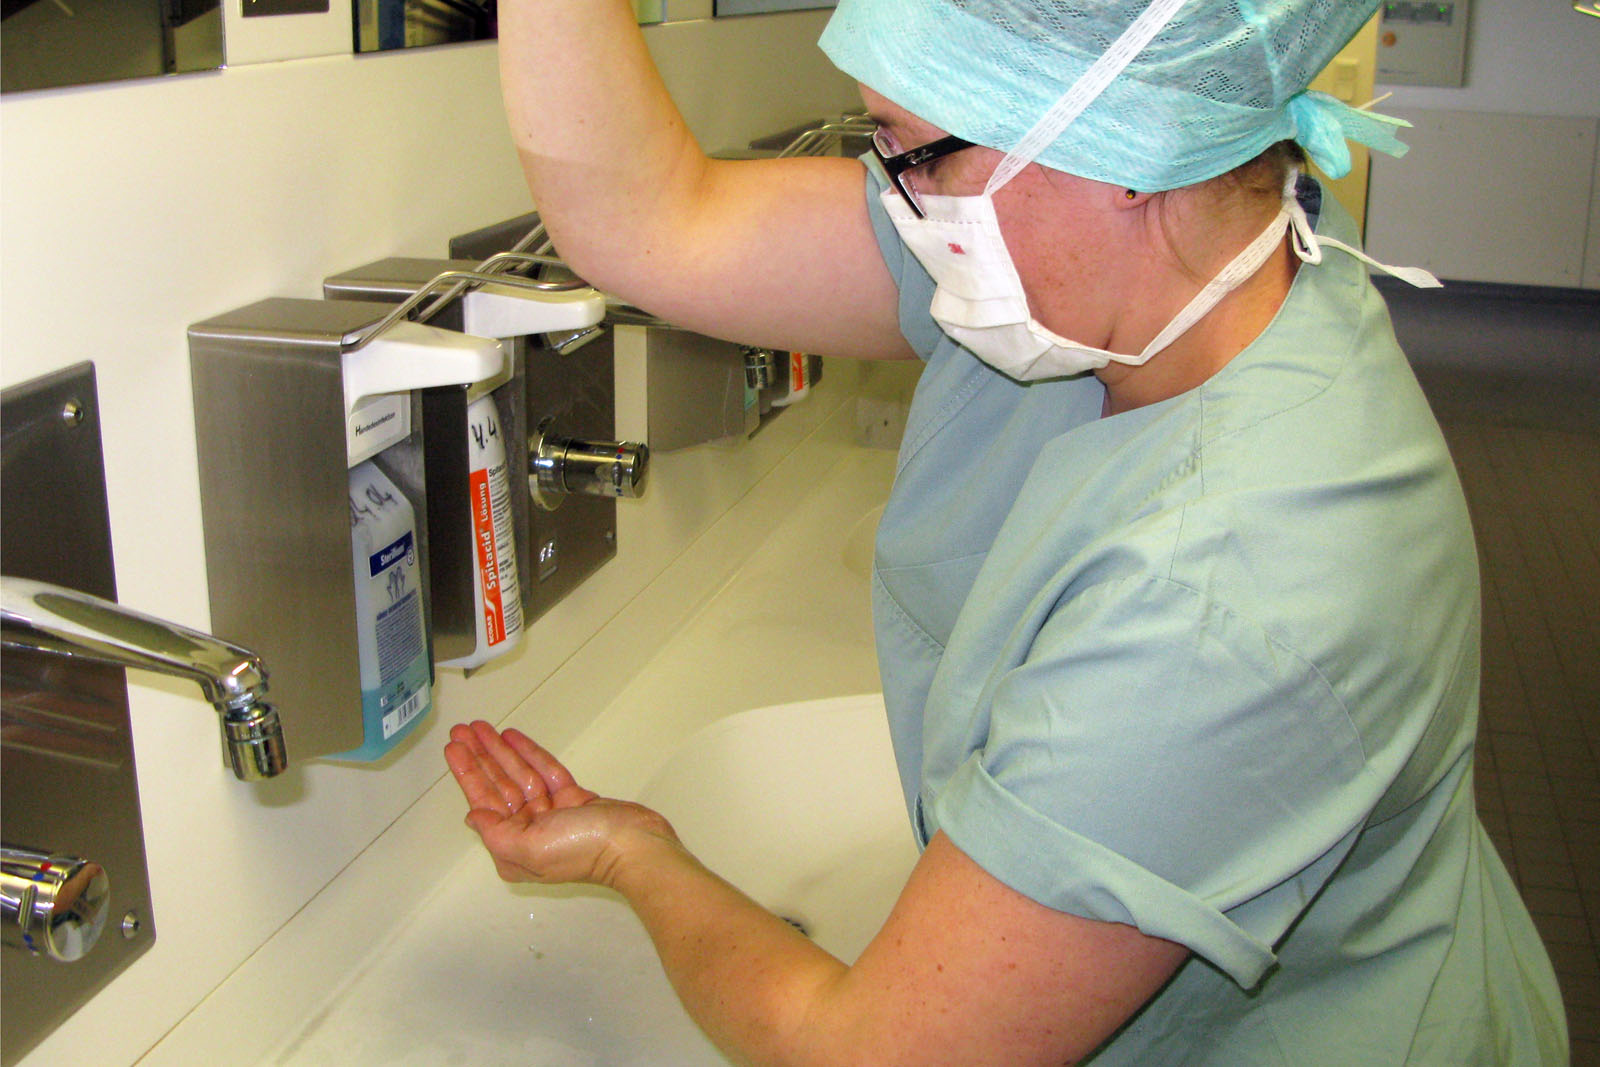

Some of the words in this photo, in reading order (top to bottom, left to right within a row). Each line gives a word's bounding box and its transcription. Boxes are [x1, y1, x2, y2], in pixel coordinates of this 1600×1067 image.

[471, 416, 498, 449] 4.4
[480, 482, 489, 522] Lösung
[481, 531, 497, 590] Spitacid
